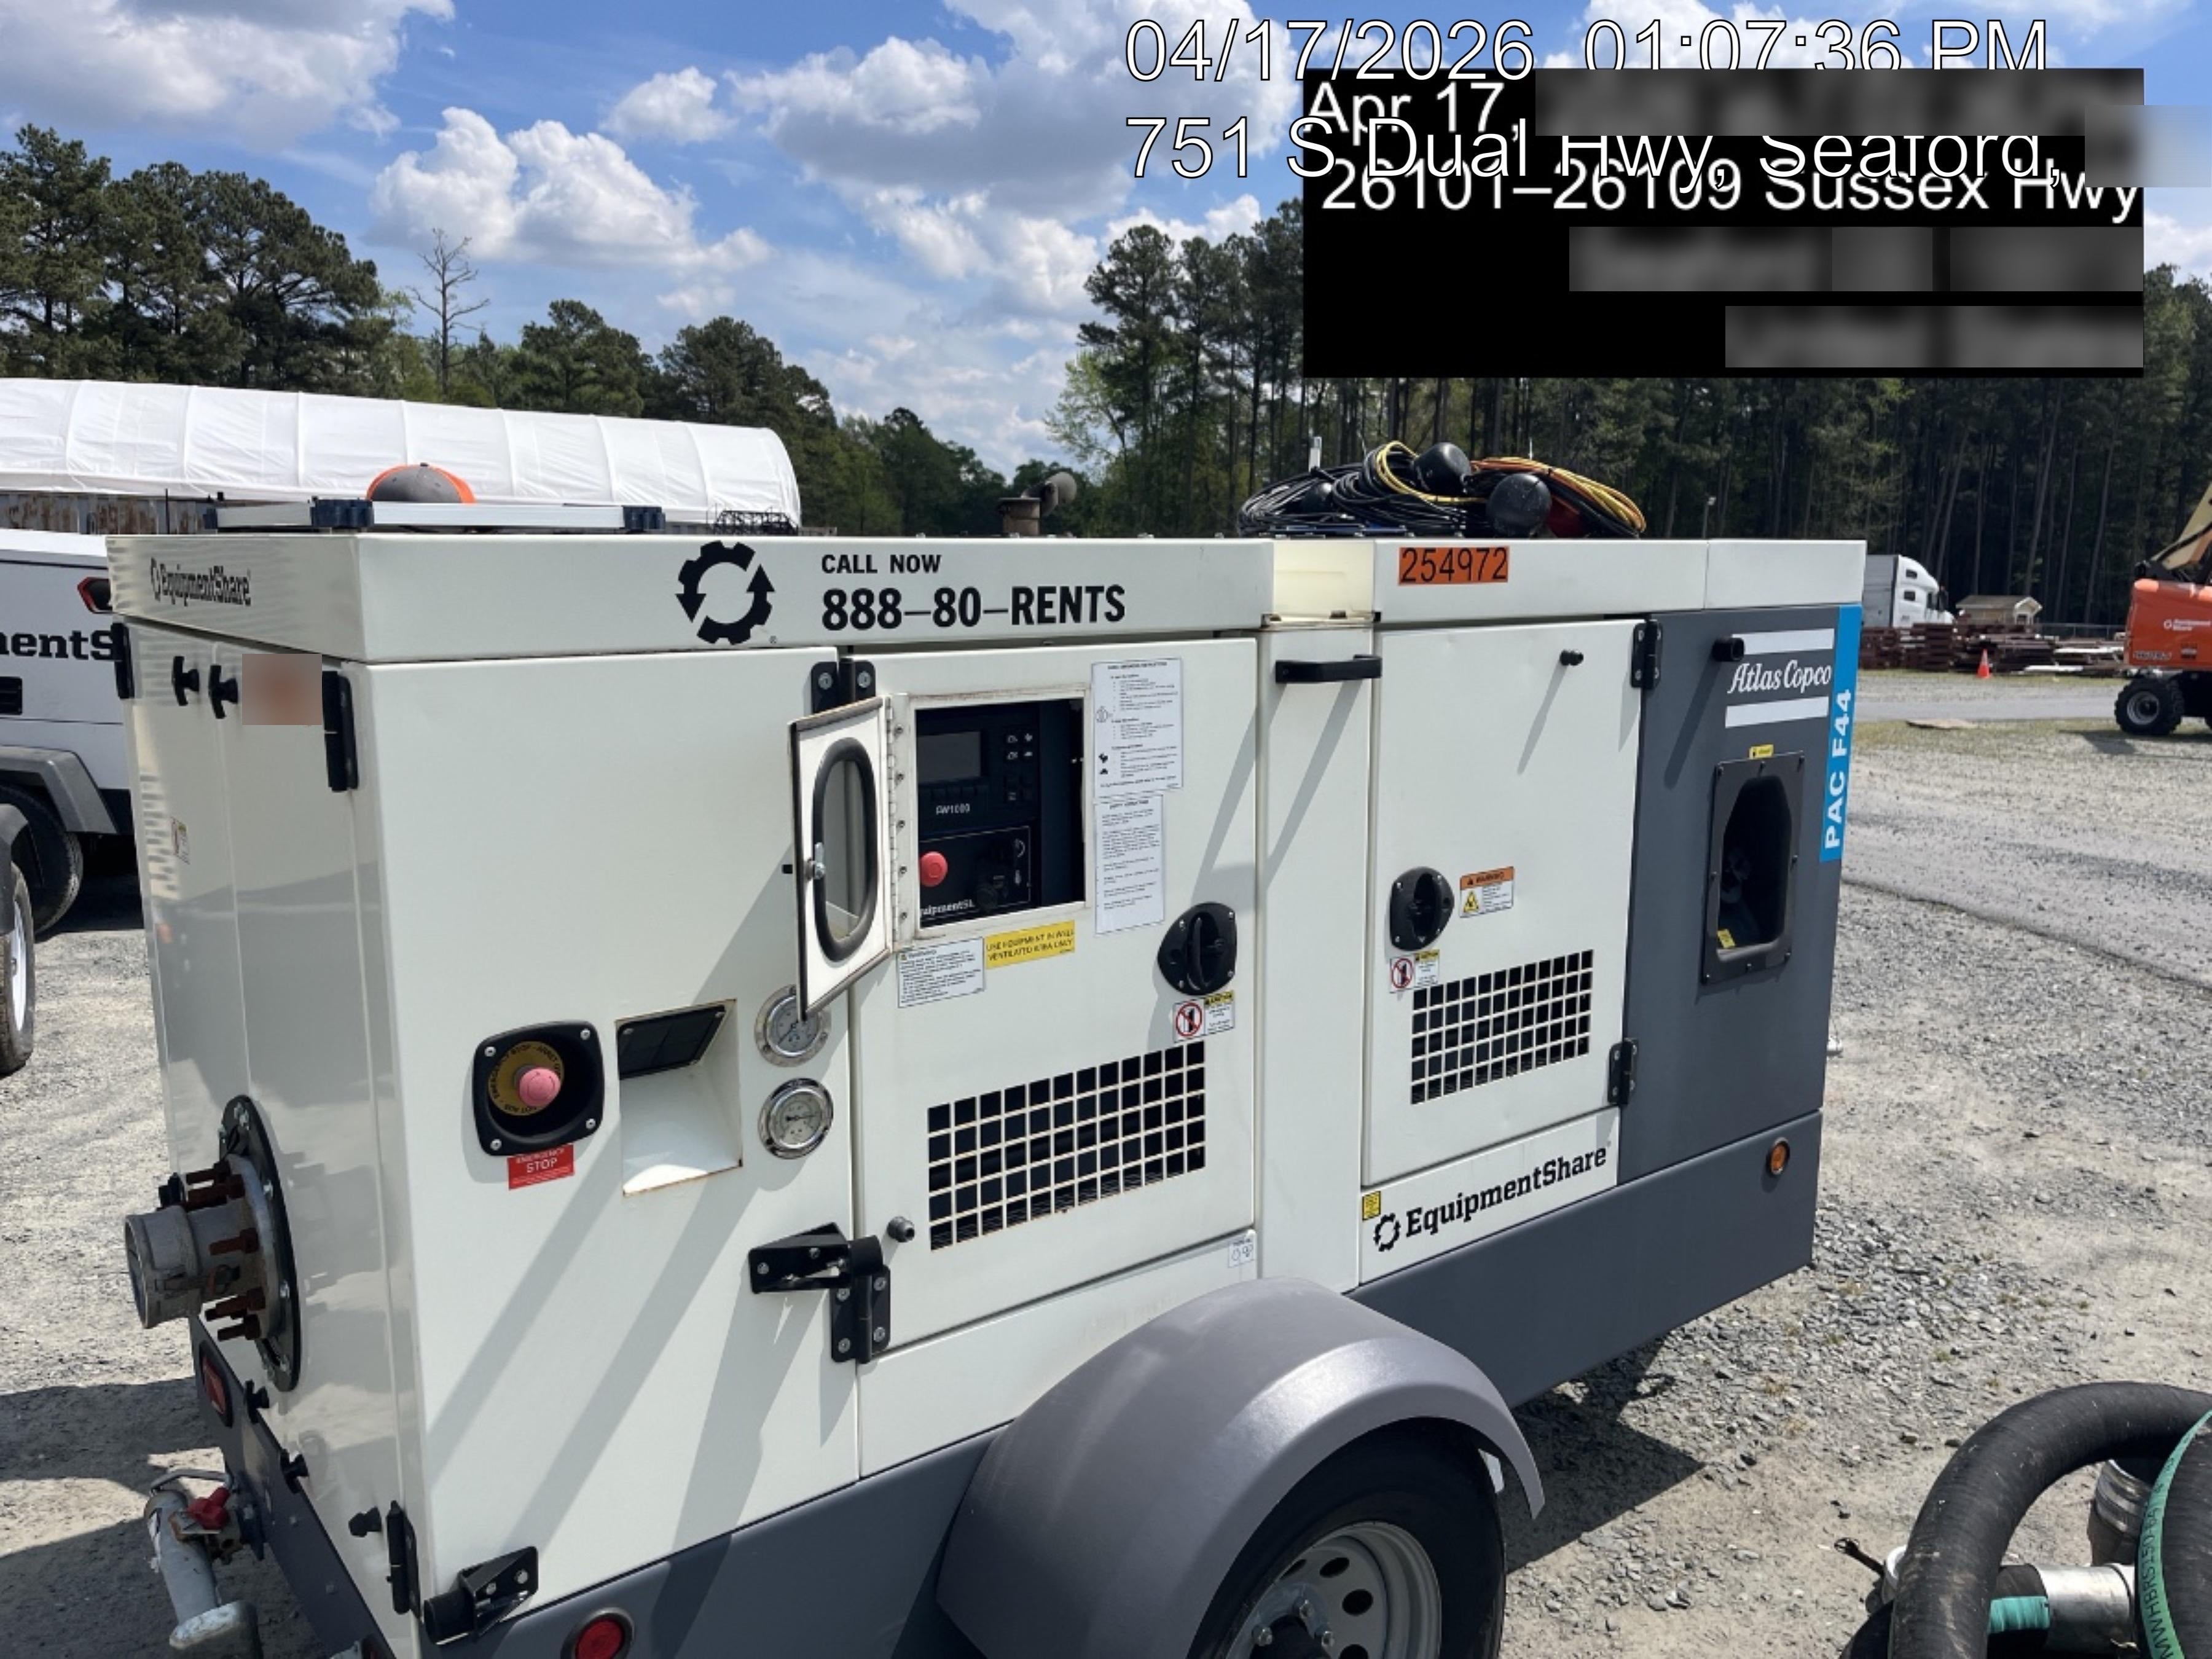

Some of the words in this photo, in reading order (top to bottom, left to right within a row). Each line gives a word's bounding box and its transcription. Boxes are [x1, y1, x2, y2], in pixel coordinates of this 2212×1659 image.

[821, 554, 877, 574] CALL
[889, 554, 943, 574] NOW
[1400, 547, 1507, 583] 254972
[822, 584, 1126, 630] 888-80-RENTS
[1727, 662, 1782, 694] Atlas
[1783, 659, 1832, 692] Copco
[1832, 689, 1852, 758] F44
[1825, 771, 1845, 850] PAC
[527, 1158, 557, 1174] STOP
[1405, 1147, 1607, 1237] EquipmentShare
